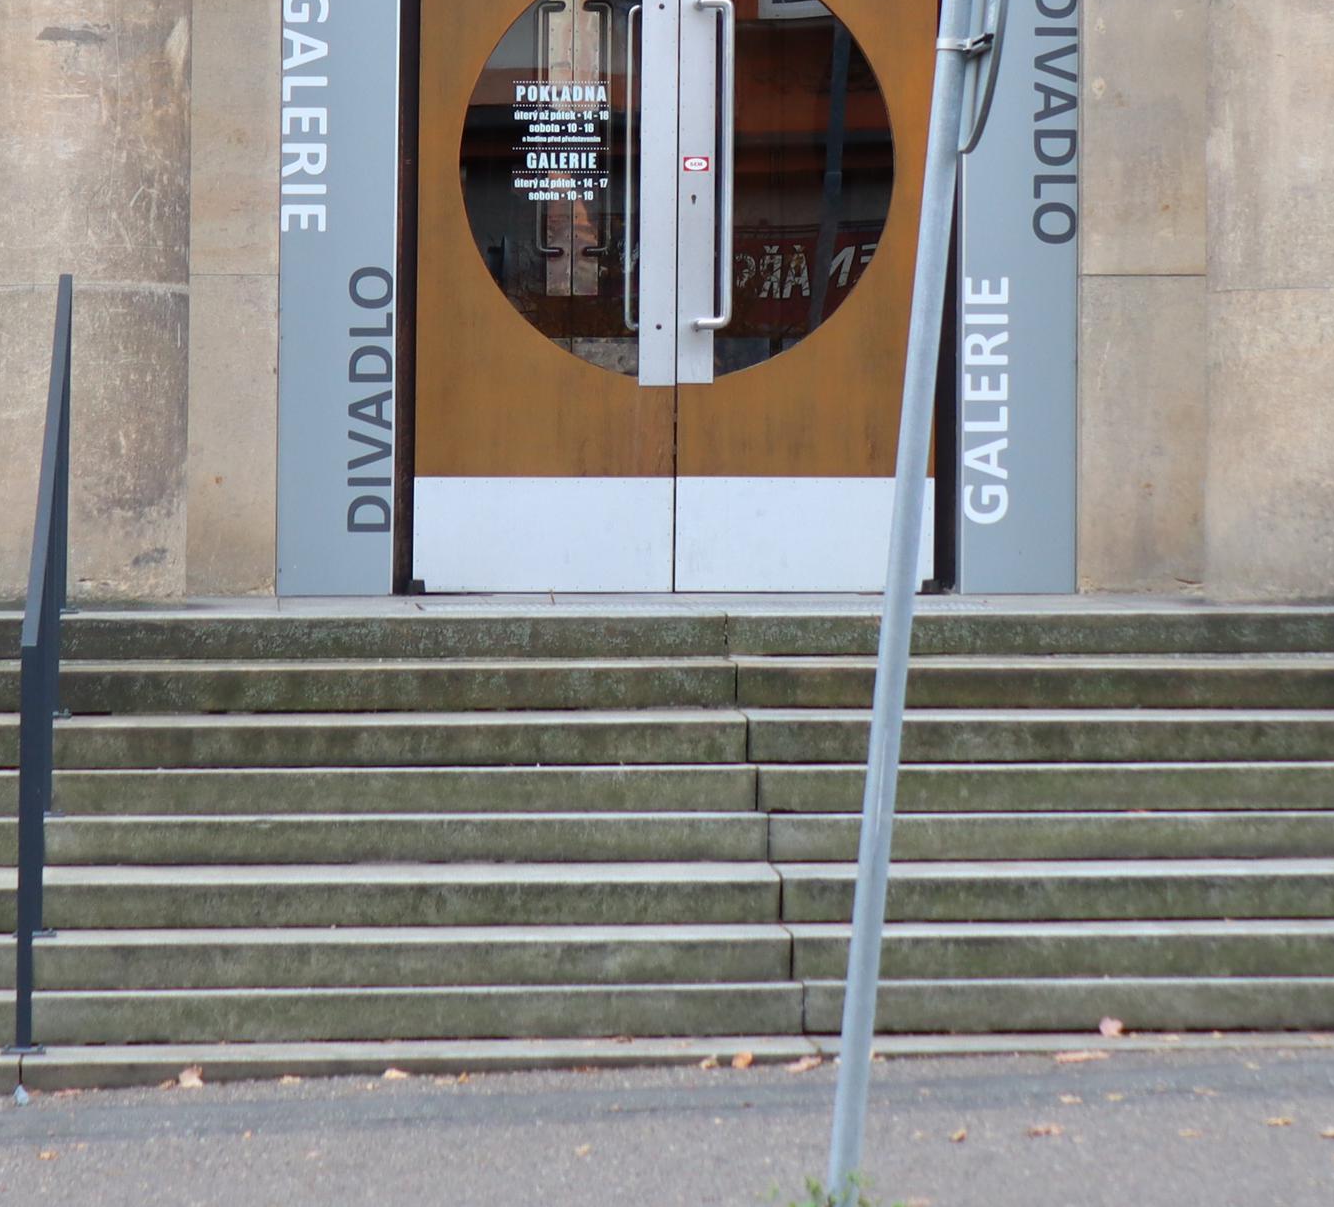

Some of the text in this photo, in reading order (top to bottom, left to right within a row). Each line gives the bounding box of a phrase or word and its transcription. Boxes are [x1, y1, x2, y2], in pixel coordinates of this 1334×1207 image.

[516, 85, 607, 102] POKLADNA
[583, 111, 593, 120] 14
[529, 123, 560, 133] sobota
[567, 123, 577, 132] 10
[526, 152, 597, 169] GALERIE
[583, 178, 593, 188] 14
[599, 178, 608, 188] 17
[528, 191, 559, 201] sobota
[566, 191, 577, 201] 10
[347, 267, 393, 532] DIVADLO
[964, 277, 1009, 524] GALERIE
